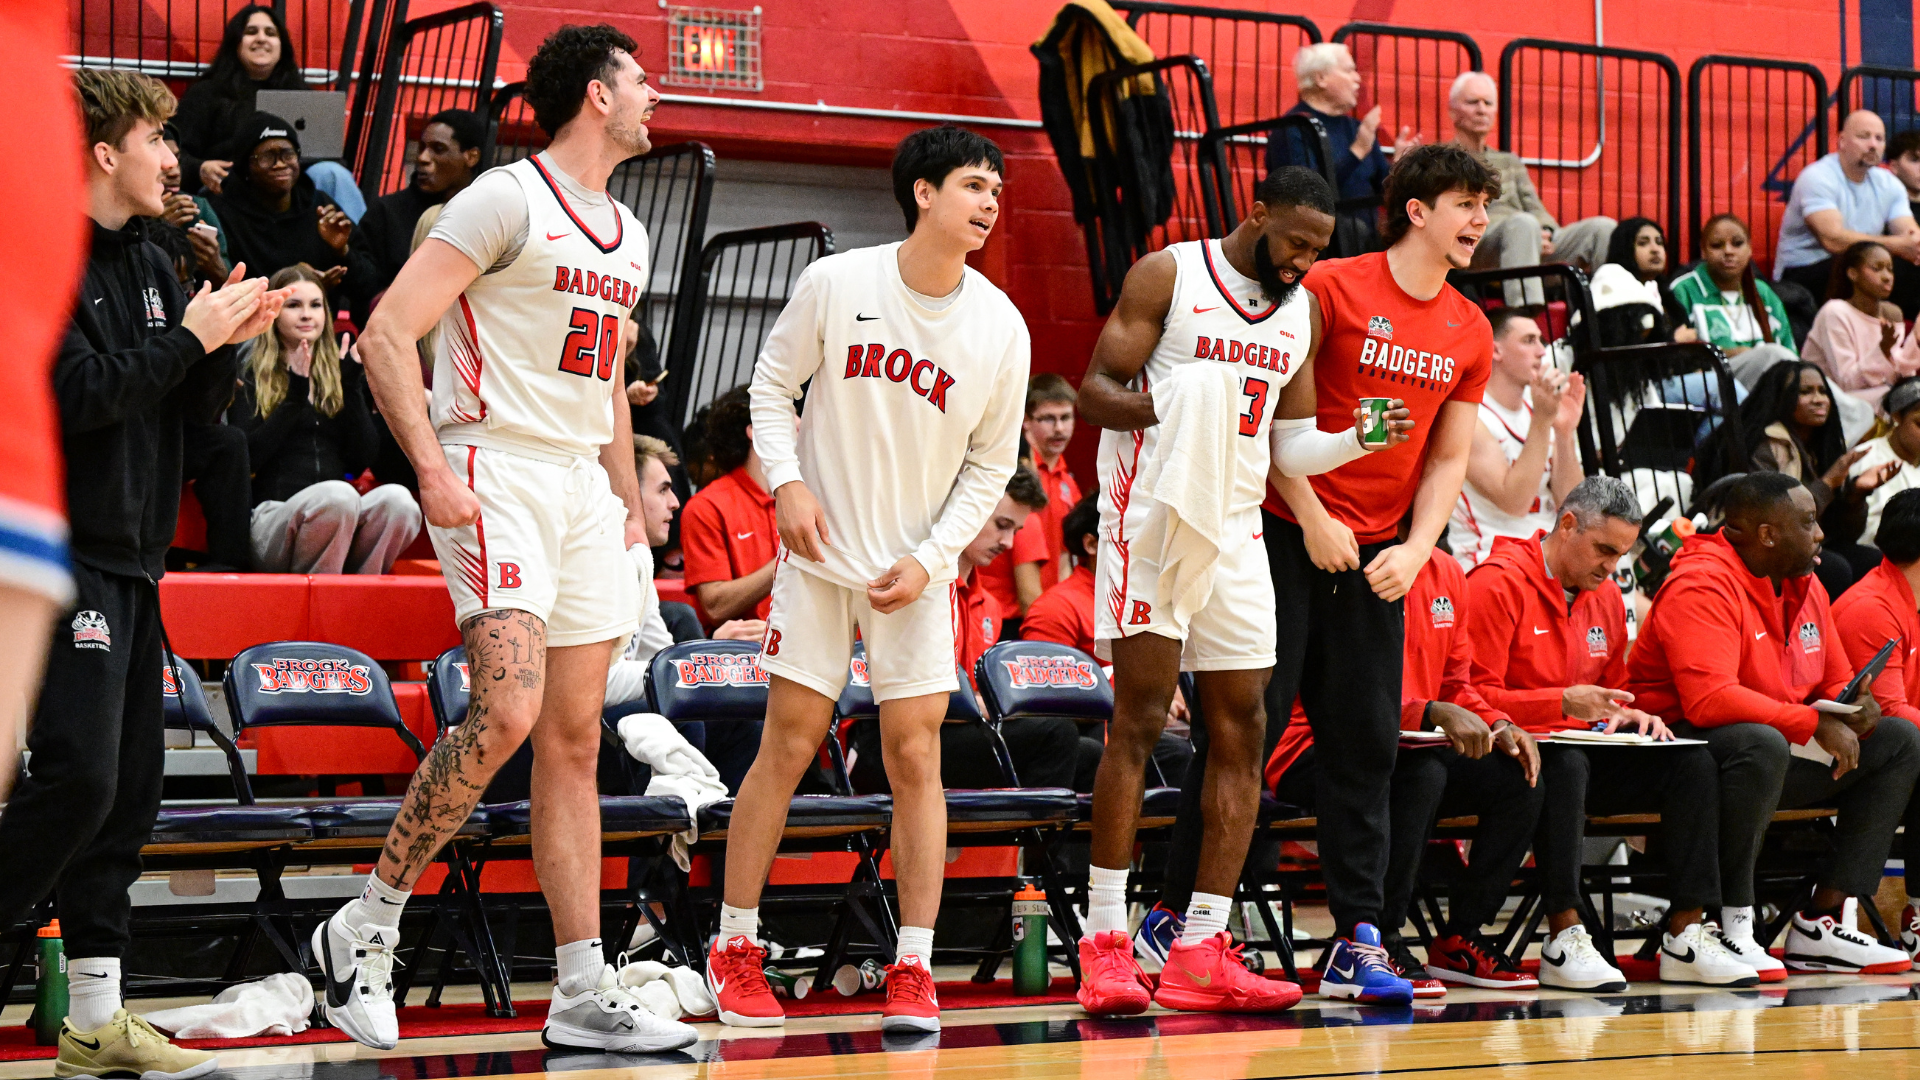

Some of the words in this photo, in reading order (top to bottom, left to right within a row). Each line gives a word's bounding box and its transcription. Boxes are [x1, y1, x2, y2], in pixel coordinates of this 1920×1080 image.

[684, 26, 737, 73] EXIT
[553, 265, 638, 310] BADGERS
[558, 307, 619, 381] 20
[1279, 330, 1295, 340] OUA
[1194, 336, 1291, 375] BADGERS
[1359, 337, 1456, 384] BADGERS
[843, 343, 956, 415] BROCK
[497, 562, 522, 589] B
[1128, 599, 1152, 625] B
[766, 628, 782, 657] B
[275, 659, 349, 671] BROCK
[678, 661, 770, 685] BADGER
[1006, 662, 1095, 687] BADGERS
[1018, 657, 1075, 668] BROCK
[256, 665, 369, 693] BADGERS
[1192, 909, 1212, 917] CEBL
